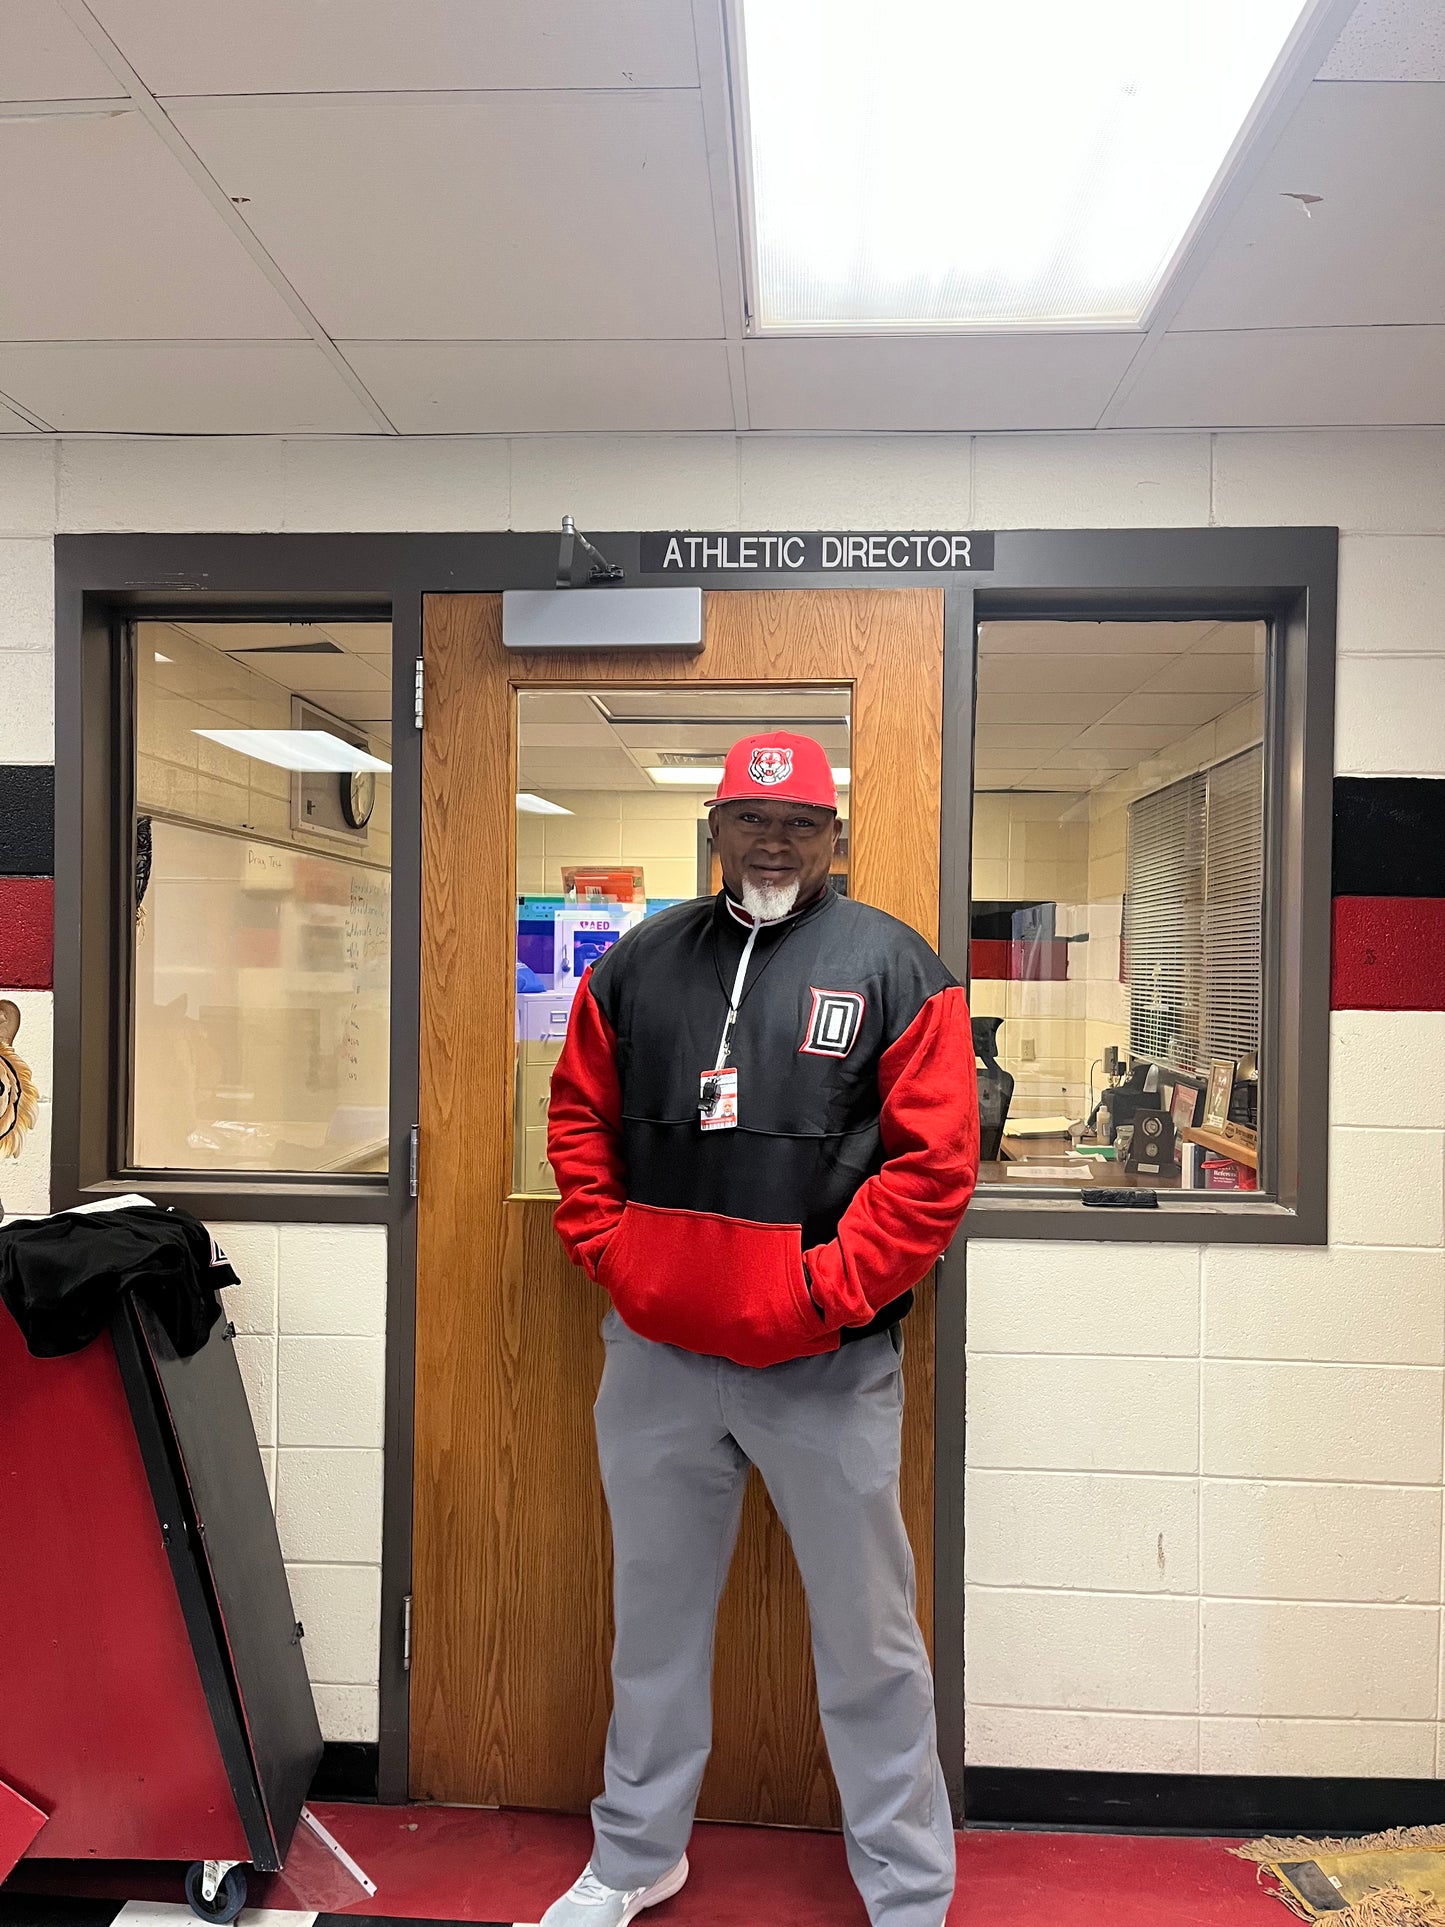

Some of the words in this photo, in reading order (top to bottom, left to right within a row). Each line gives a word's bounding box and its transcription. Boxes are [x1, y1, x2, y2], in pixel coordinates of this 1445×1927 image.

[662, 536, 805, 569] ATHLETIC
[821, 534, 972, 568] DIRECTOR
[589, 920, 610, 931] AED
